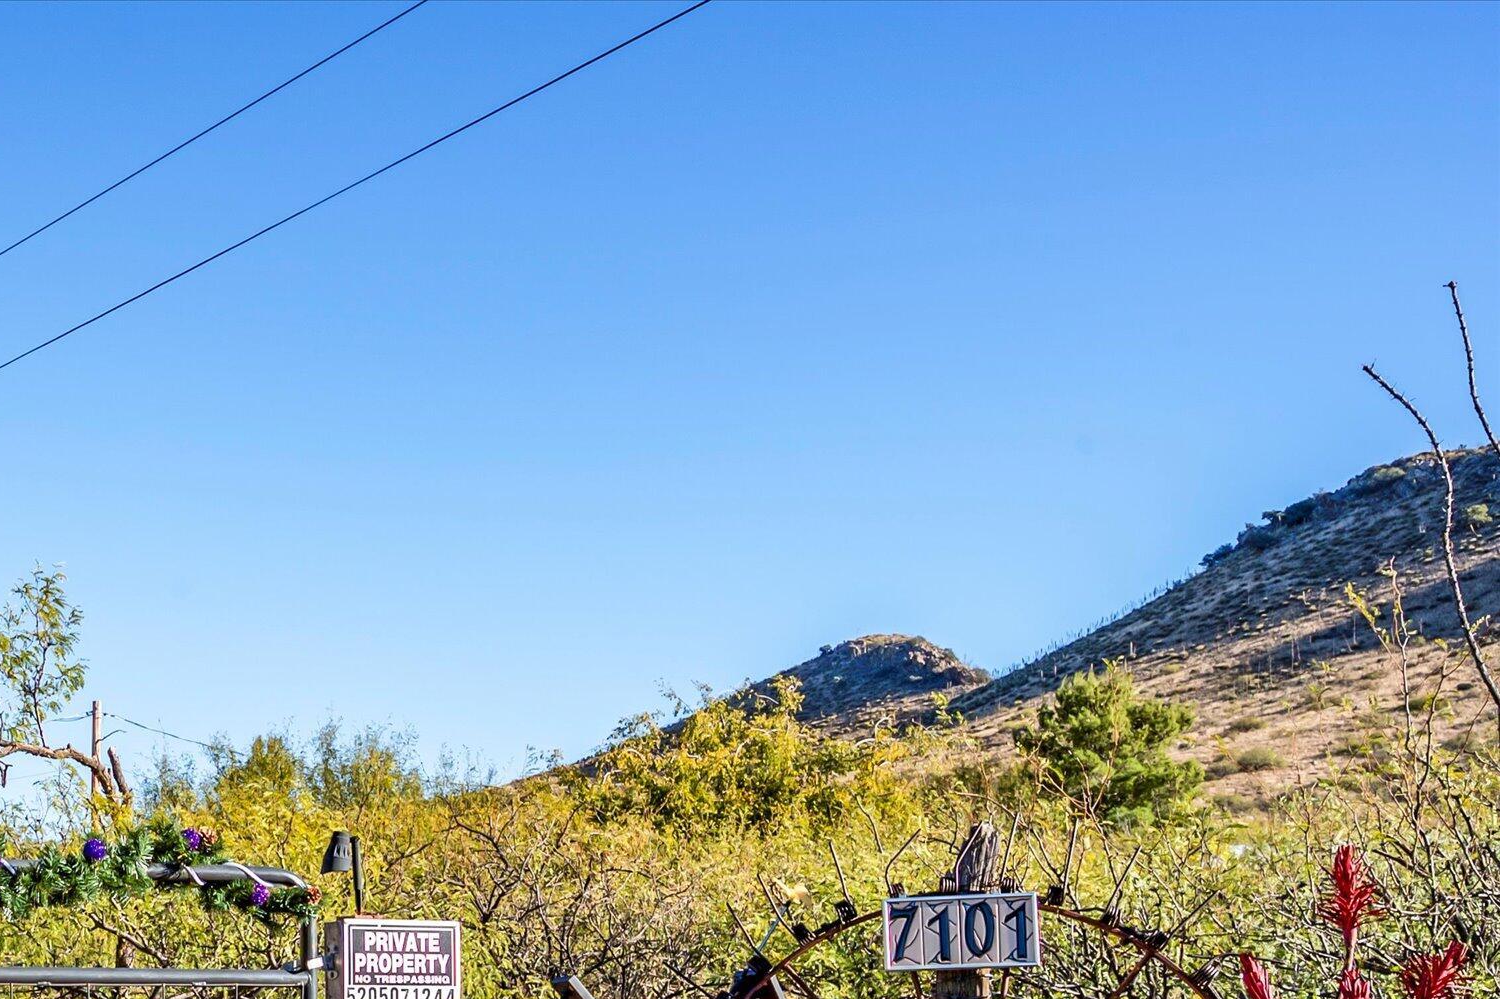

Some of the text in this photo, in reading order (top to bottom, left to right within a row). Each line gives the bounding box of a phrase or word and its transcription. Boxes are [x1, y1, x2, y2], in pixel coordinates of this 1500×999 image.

[364, 931, 440, 952] PRIVATE
[890, 901, 1028, 962] 7101
[354, 953, 450, 974] PROPERTY
[355, 975, 451, 984] NO TRESPASSING
